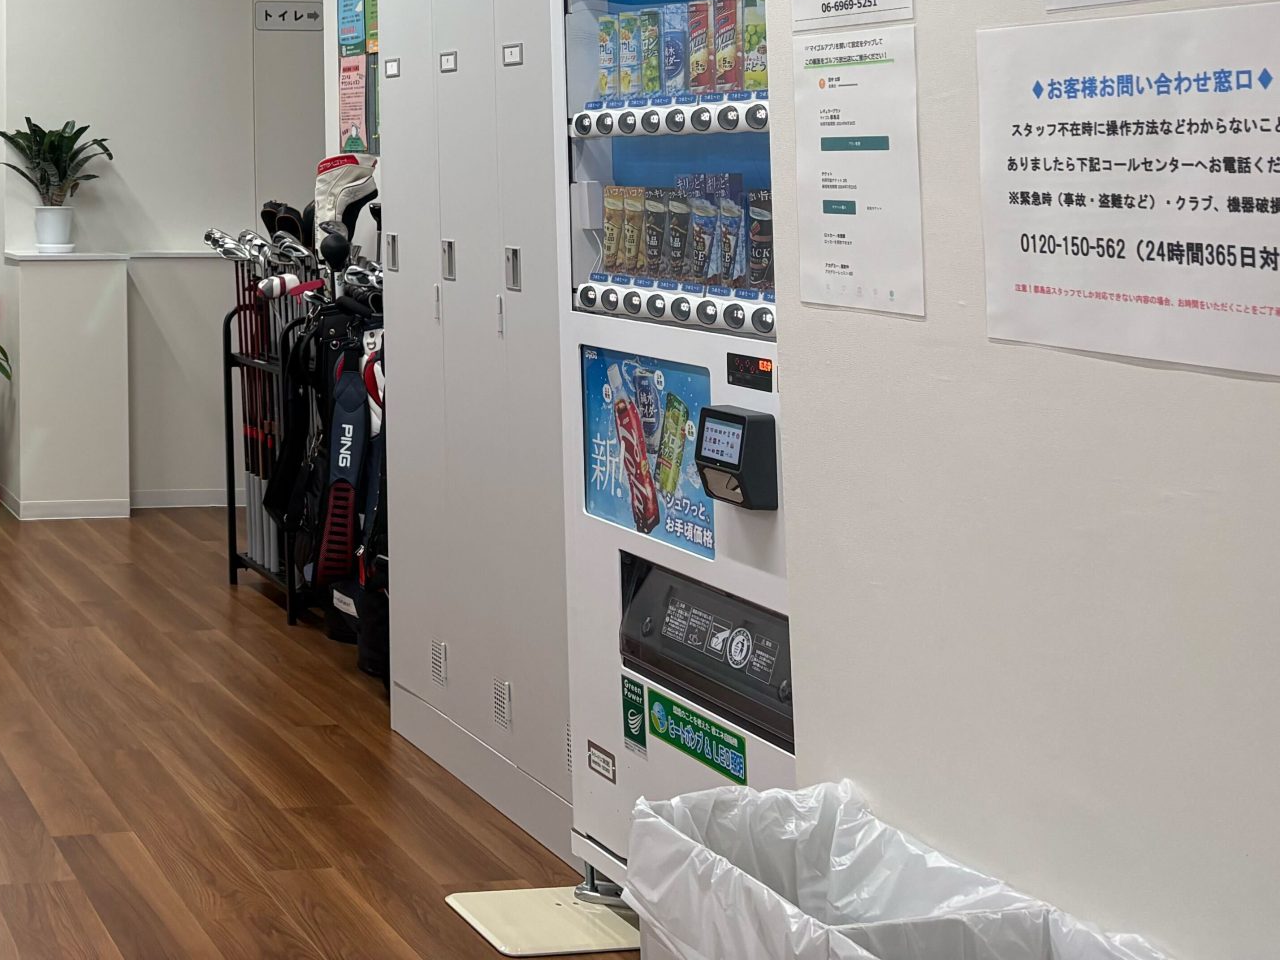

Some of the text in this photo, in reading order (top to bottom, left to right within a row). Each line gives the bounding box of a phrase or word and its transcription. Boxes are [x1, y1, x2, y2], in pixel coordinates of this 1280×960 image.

[265, 9, 304, 21] トイレ
[338, 424, 354, 468] PING
[666, 493, 710, 522] シュワっと、
[624, 679, 642, 694] Green
[624, 688, 643, 704] Power
